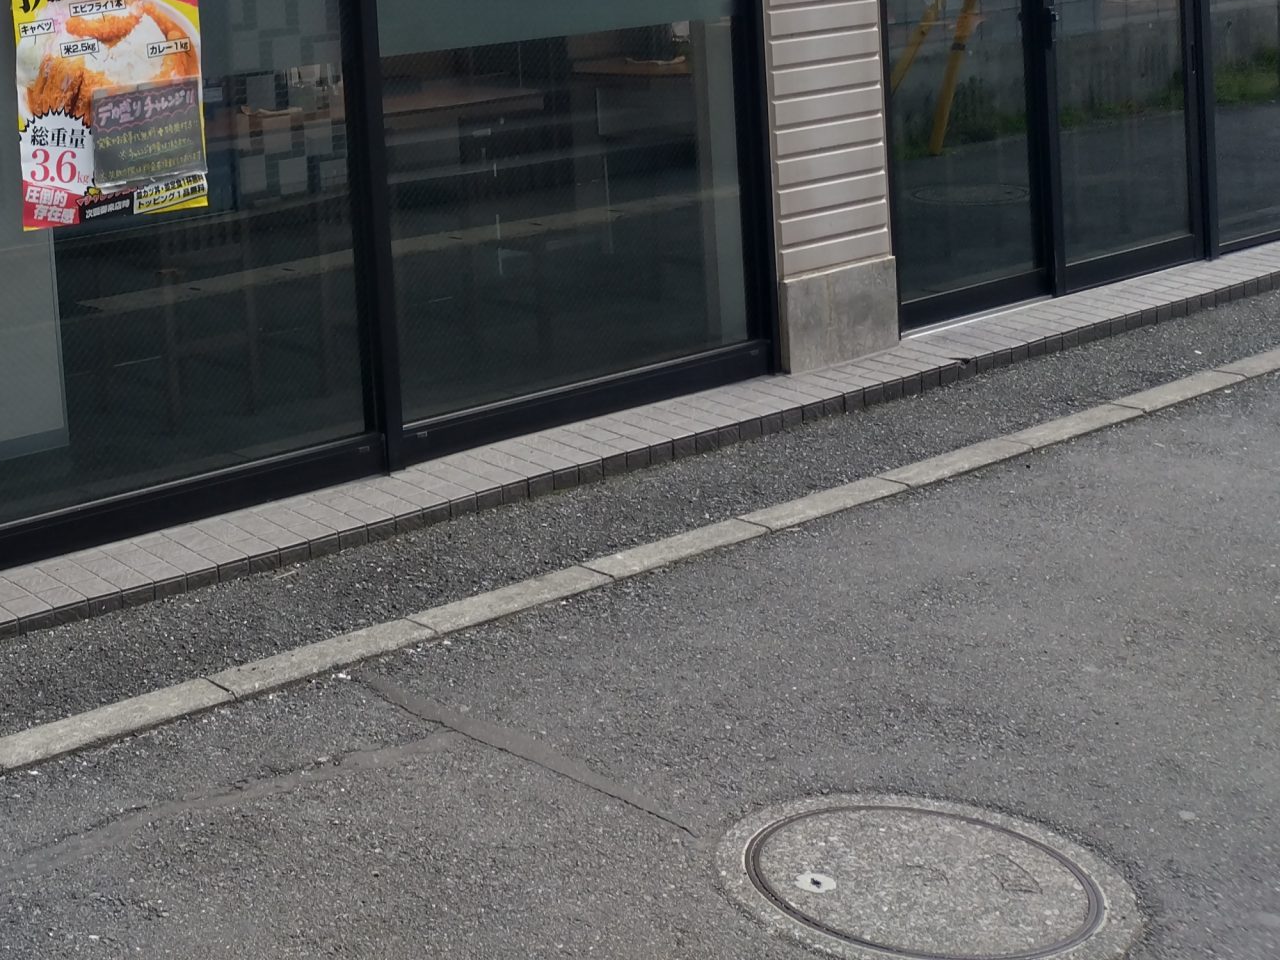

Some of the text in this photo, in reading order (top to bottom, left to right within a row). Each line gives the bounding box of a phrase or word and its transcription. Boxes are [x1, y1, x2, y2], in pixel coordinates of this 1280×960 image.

[21, 22, 52, 35] キャベツ
[63, 41, 96, 55] 米2.5kg
[149, 39, 190, 54] カレー1kg
[31, 126, 86, 148] 総重量
[25, 185, 68, 208] 圧倒的
[34, 205, 76, 224] 存在感
